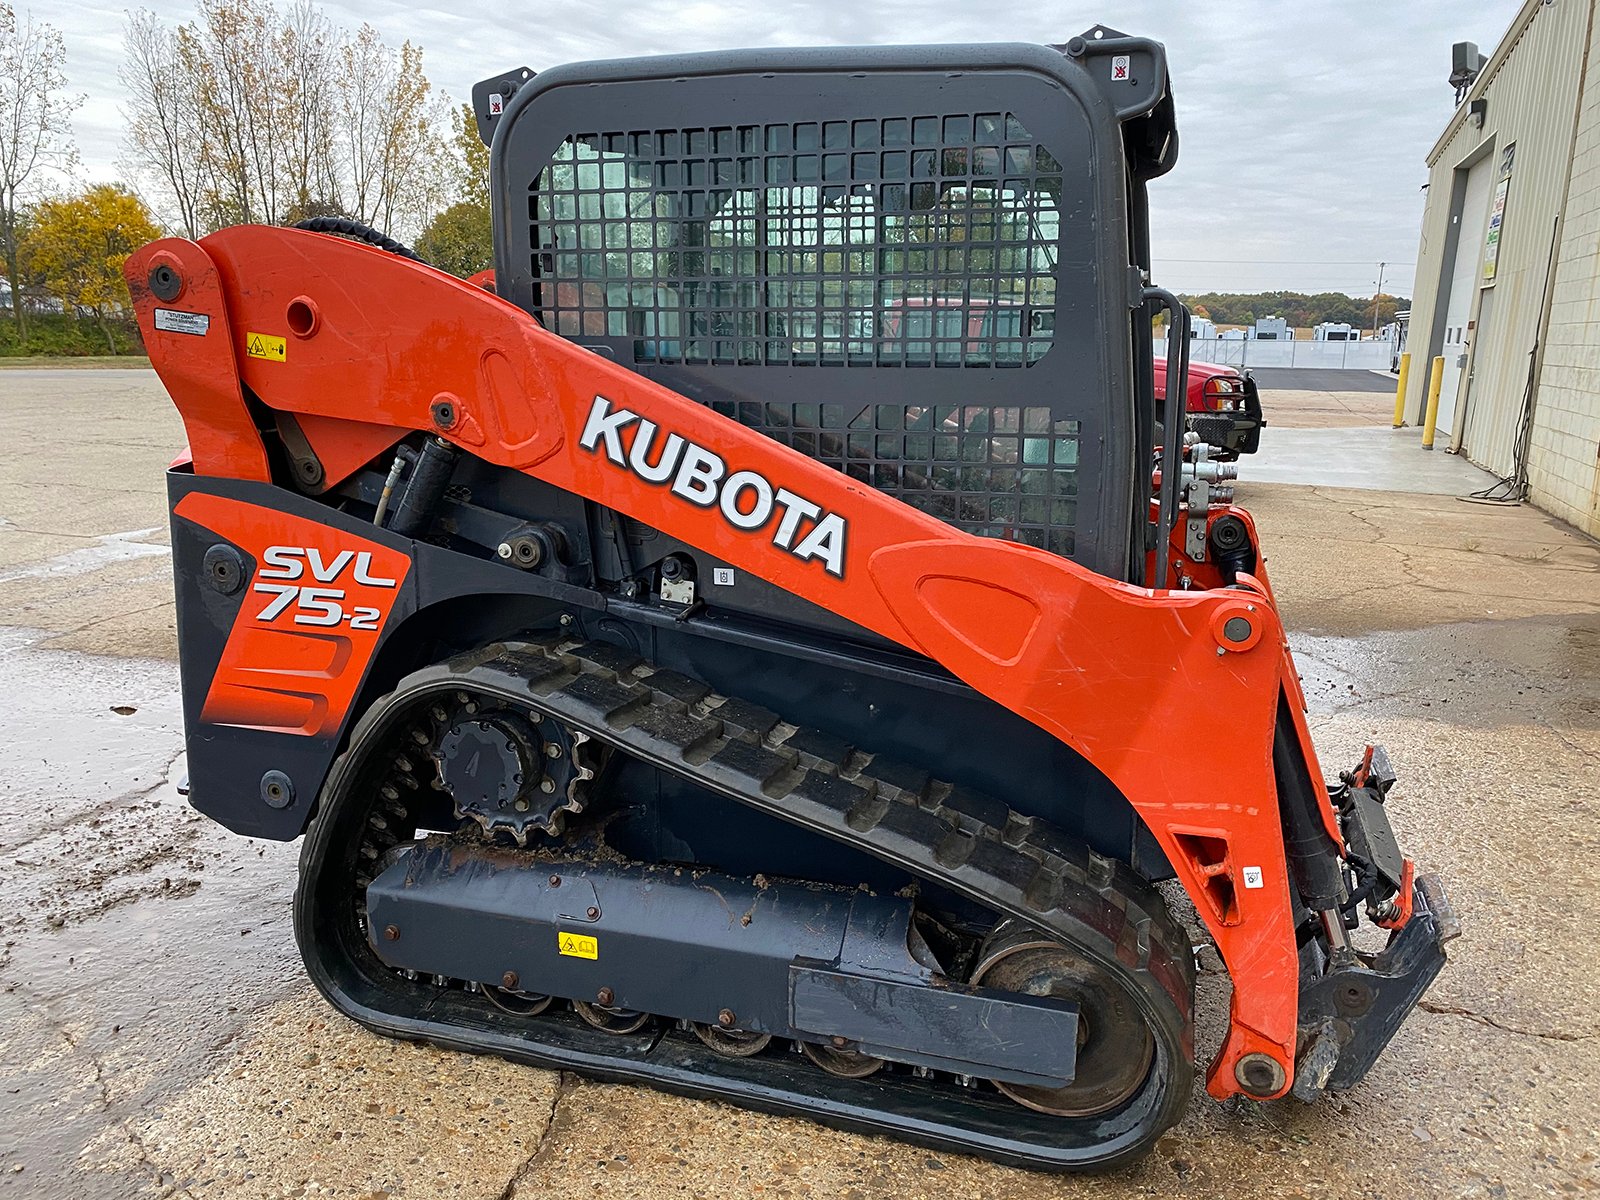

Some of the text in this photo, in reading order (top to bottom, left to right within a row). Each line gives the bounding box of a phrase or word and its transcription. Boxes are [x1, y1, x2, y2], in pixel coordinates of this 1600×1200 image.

[579, 395, 846, 578] KUBOTA
[258, 545, 396, 587] SVL
[253, 582, 382, 630] 75-2
